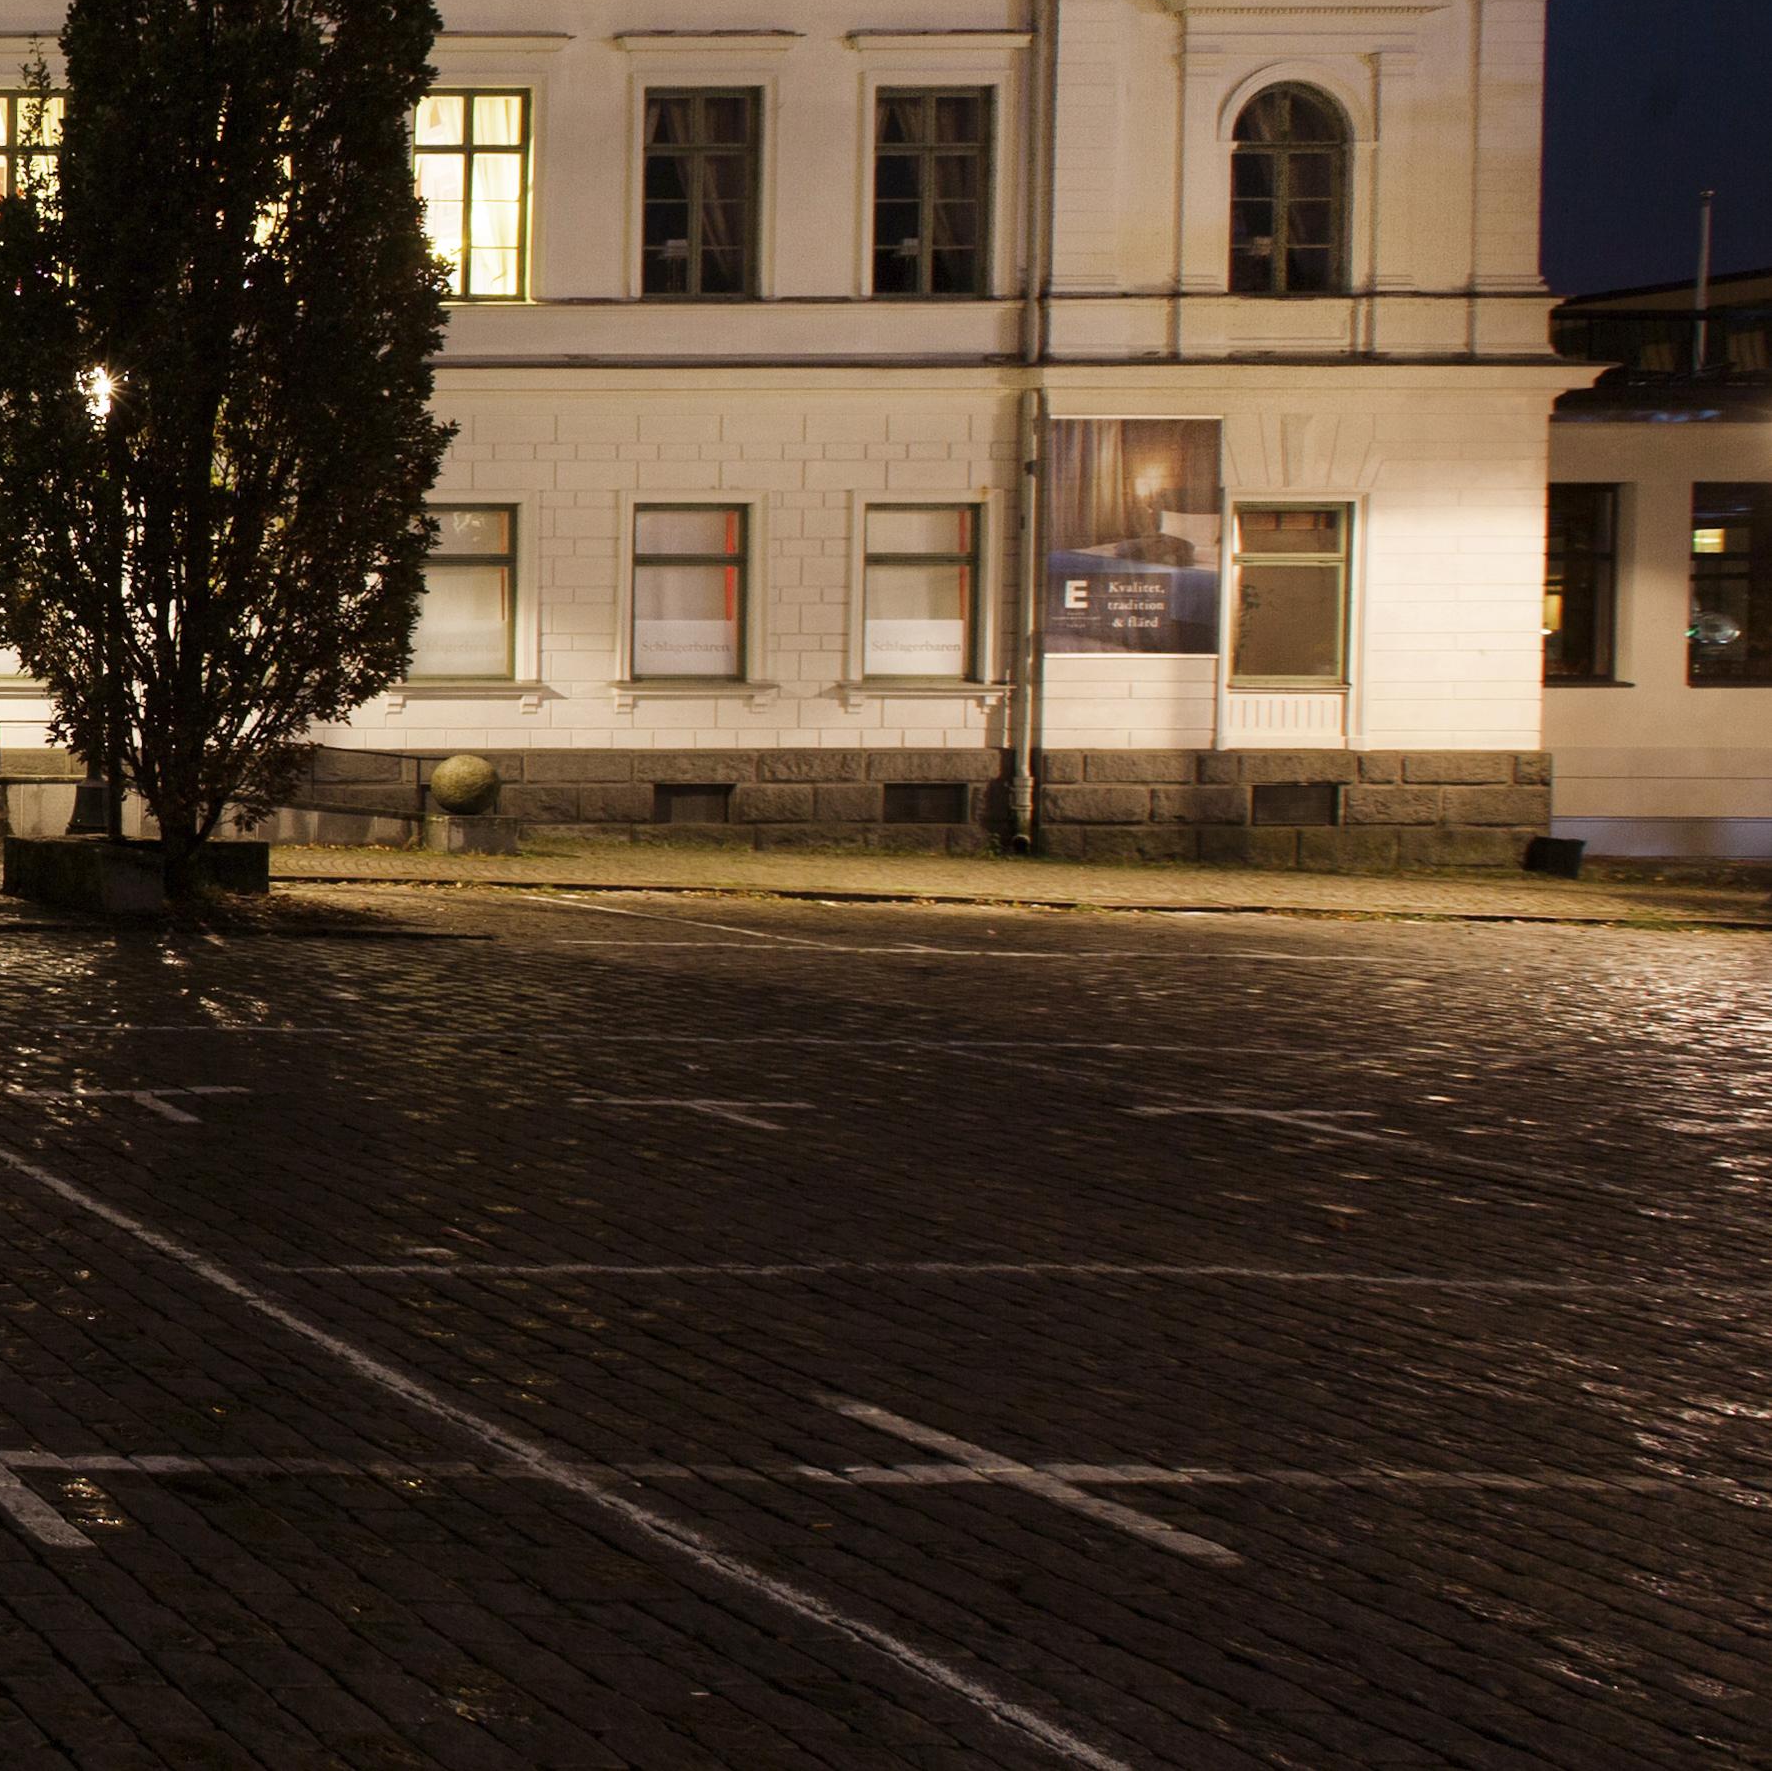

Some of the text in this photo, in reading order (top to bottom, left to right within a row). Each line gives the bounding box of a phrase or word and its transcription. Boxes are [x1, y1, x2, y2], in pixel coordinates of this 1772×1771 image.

[1064, 580, 1088, 608] E
[1108, 582, 1165, 594] Kvalitet,
[1107, 599, 1165, 611] tradition
[1112, 618, 1124, 628] &
[641, 641, 730, 654] Schlagerbaren
[872, 640, 961, 653] Schlagerbaren
